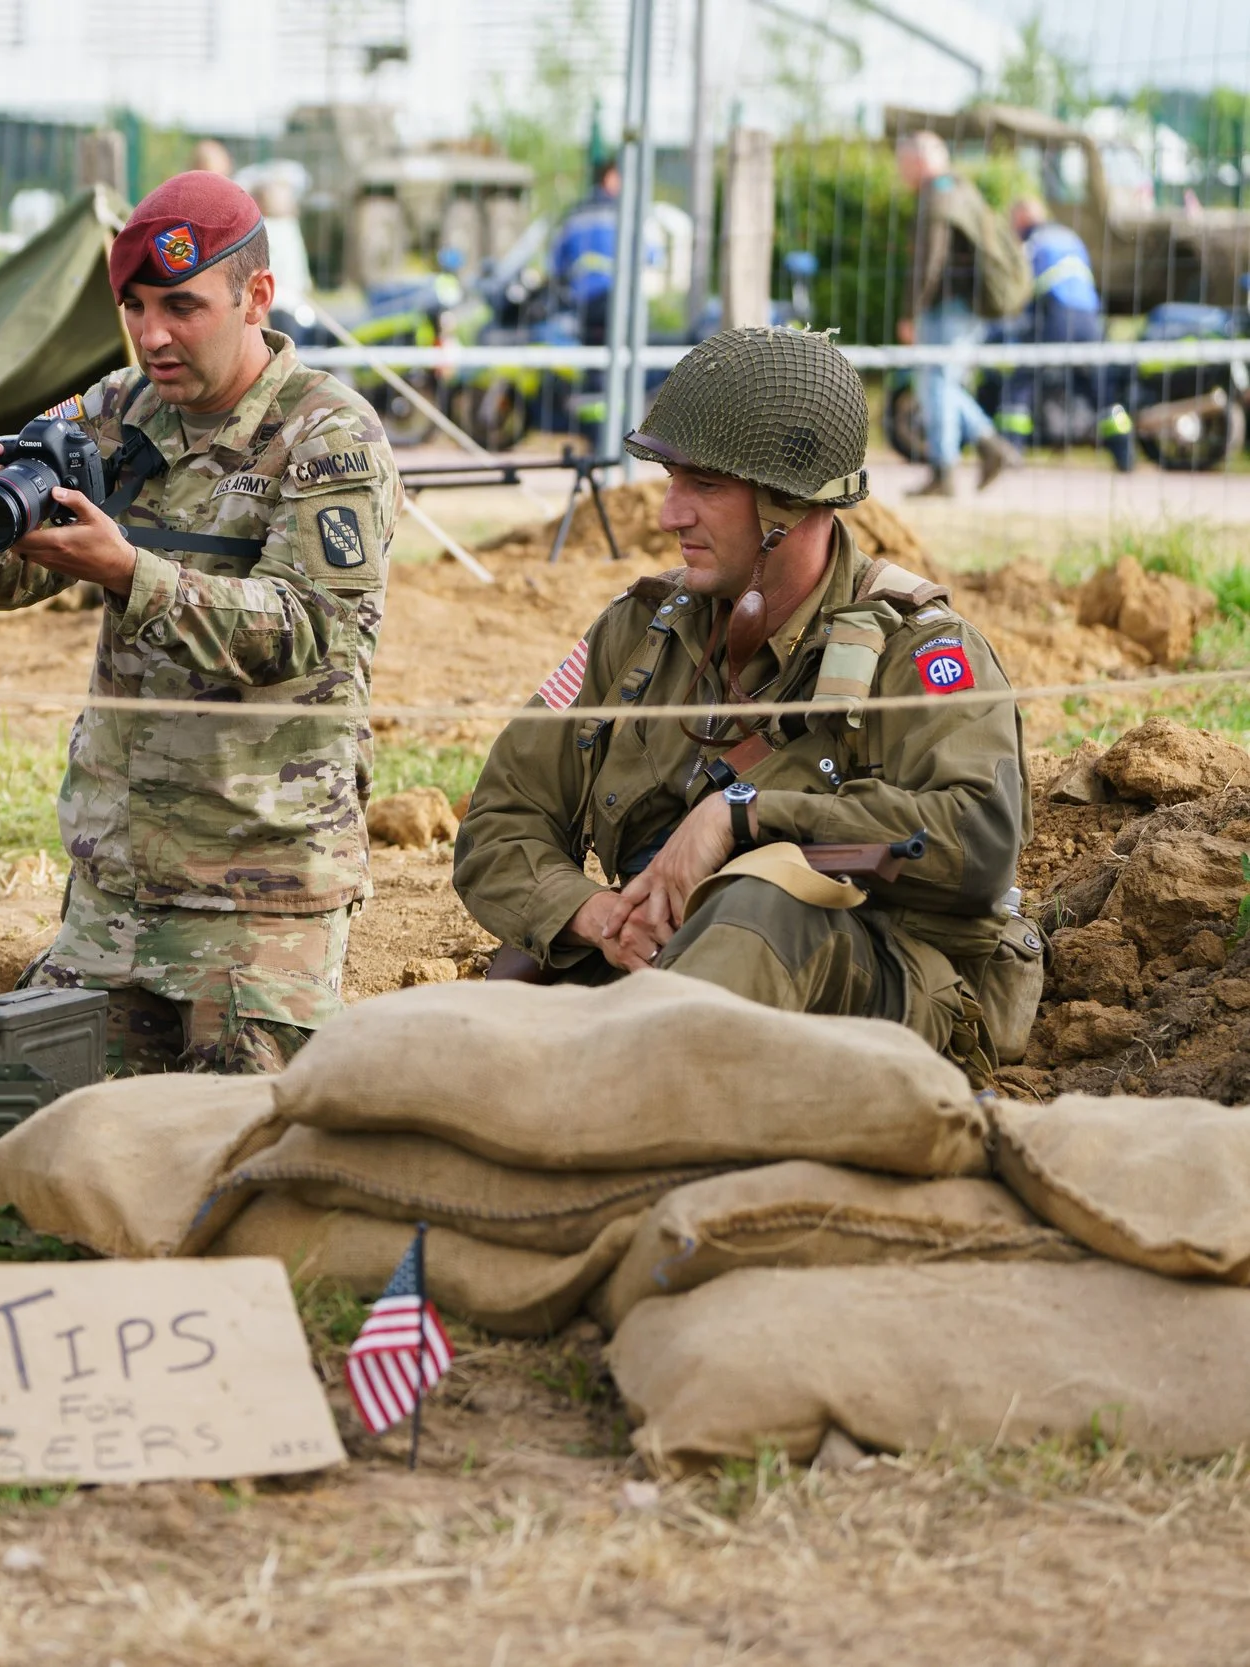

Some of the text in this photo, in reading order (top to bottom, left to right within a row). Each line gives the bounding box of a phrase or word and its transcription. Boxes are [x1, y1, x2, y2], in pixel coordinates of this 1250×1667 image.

[296, 450, 370, 482] COMCAM
[232, 476, 271, 495] ARMY
[915, 637, 961, 656] AIRBORNE
[929, 657, 962, 684] AA
